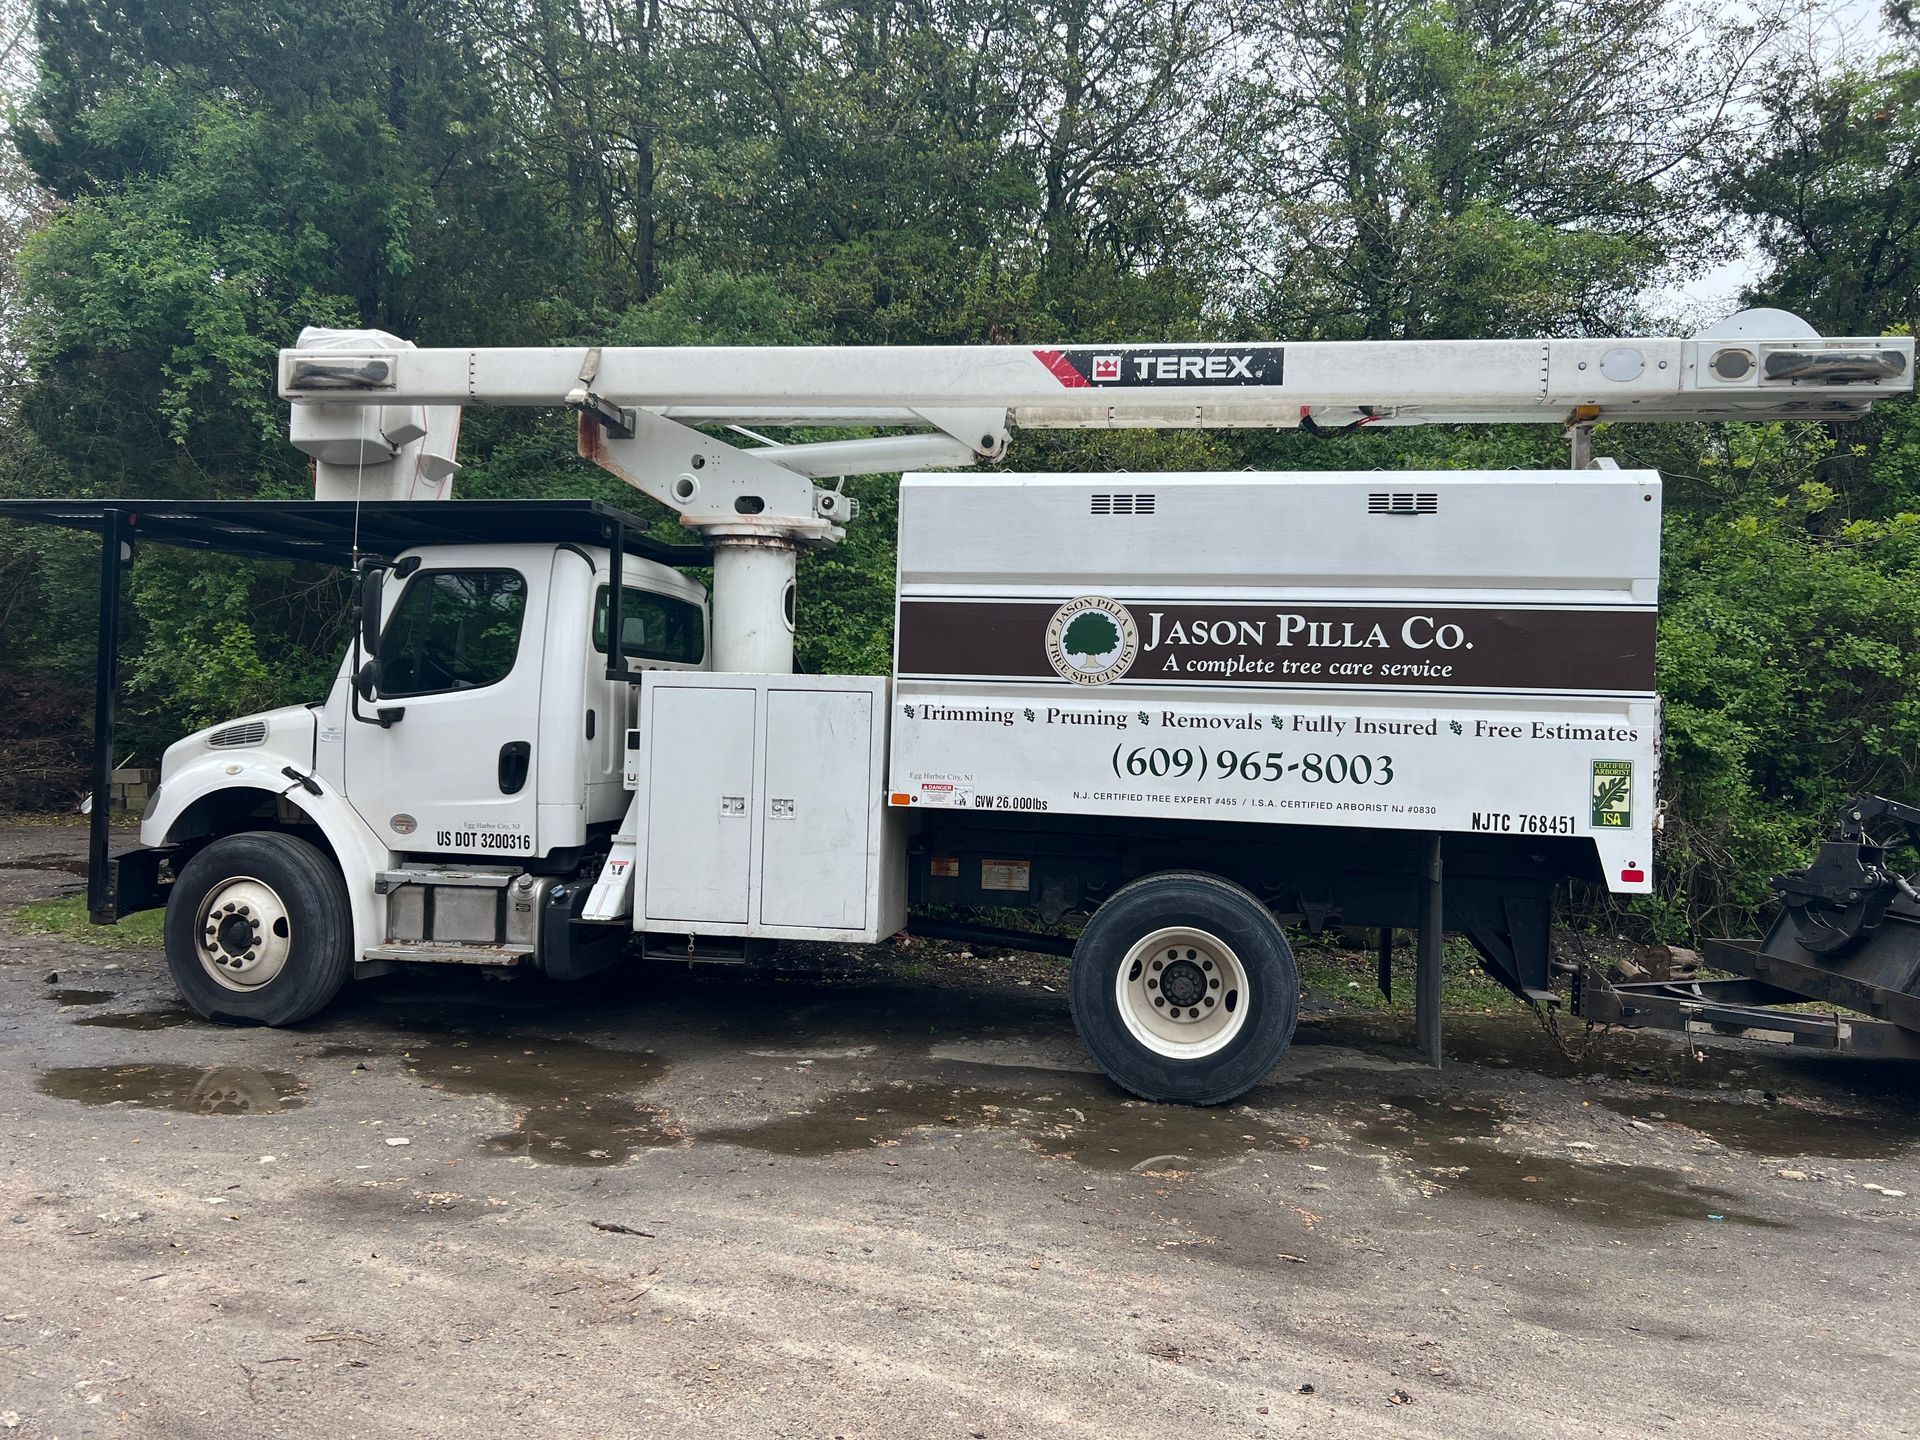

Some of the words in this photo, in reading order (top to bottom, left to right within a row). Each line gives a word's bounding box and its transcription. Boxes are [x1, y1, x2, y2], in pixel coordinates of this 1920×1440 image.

[1133, 355, 1253, 379] TEREX
[1056, 598, 1092, 626] JASON
[1097, 598, 1129, 627] PILLA
[1049, 640, 1071, 674] TREE
[1070, 641, 1134, 684] SPECIALIST
[1162, 653, 1180, 671] A
[1186, 655, 1275, 677] complete
[1282, 658, 1322, 674] tree
[1329, 661, 1373, 676] care
[1380, 659, 1453, 678] service
[919, 704, 1015, 727] Trimming
[1046, 707, 1128, 730] Pruning
[1161, 710, 1263, 731] Removals
[1292, 714, 1347, 737] Fully
[1354, 716, 1438, 736] Insured
[1474, 719, 1523, 739] Free
[1530, 721, 1639, 742] Estimates
[1594, 761, 1631, 769] CERTIFIED
[1594, 768, 1630, 776] ARBORIST
[909, 771, 923, 781] Egg
[923, 772, 946, 781] Harbor
[964, 774, 974, 782] NJ
[975, 795, 993, 809] GVW
[996, 796, 1048, 811] 26,000lbs
[1073, 791, 1091, 800] N.J.
[1093, 792, 1143, 802] CERTIFIED
[1146, 794, 1171, 803] TREE
[1174, 796, 1213, 805] EXPERT
[1215, 797, 1237, 806] #455
[1251, 799, 1277, 808] I.S.A.
[1280, 800, 1333, 810] CERTIFIED
[1336, 802, 1388, 812] ARBORIST
[1391, 805, 1404, 813] NJ
[1407, 806, 1436, 815] #0830
[464, 821, 475, 830] Egg
[477, 822, 496, 830] Harbor
[1471, 812, 1510, 832] NJTC
[1519, 814, 1575, 834] 768451
[1602, 812, 1622, 826] ISA
[437, 831, 451, 847] US
[455, 832, 477, 847] DOT
[481, 833, 530, 850] 3200316
